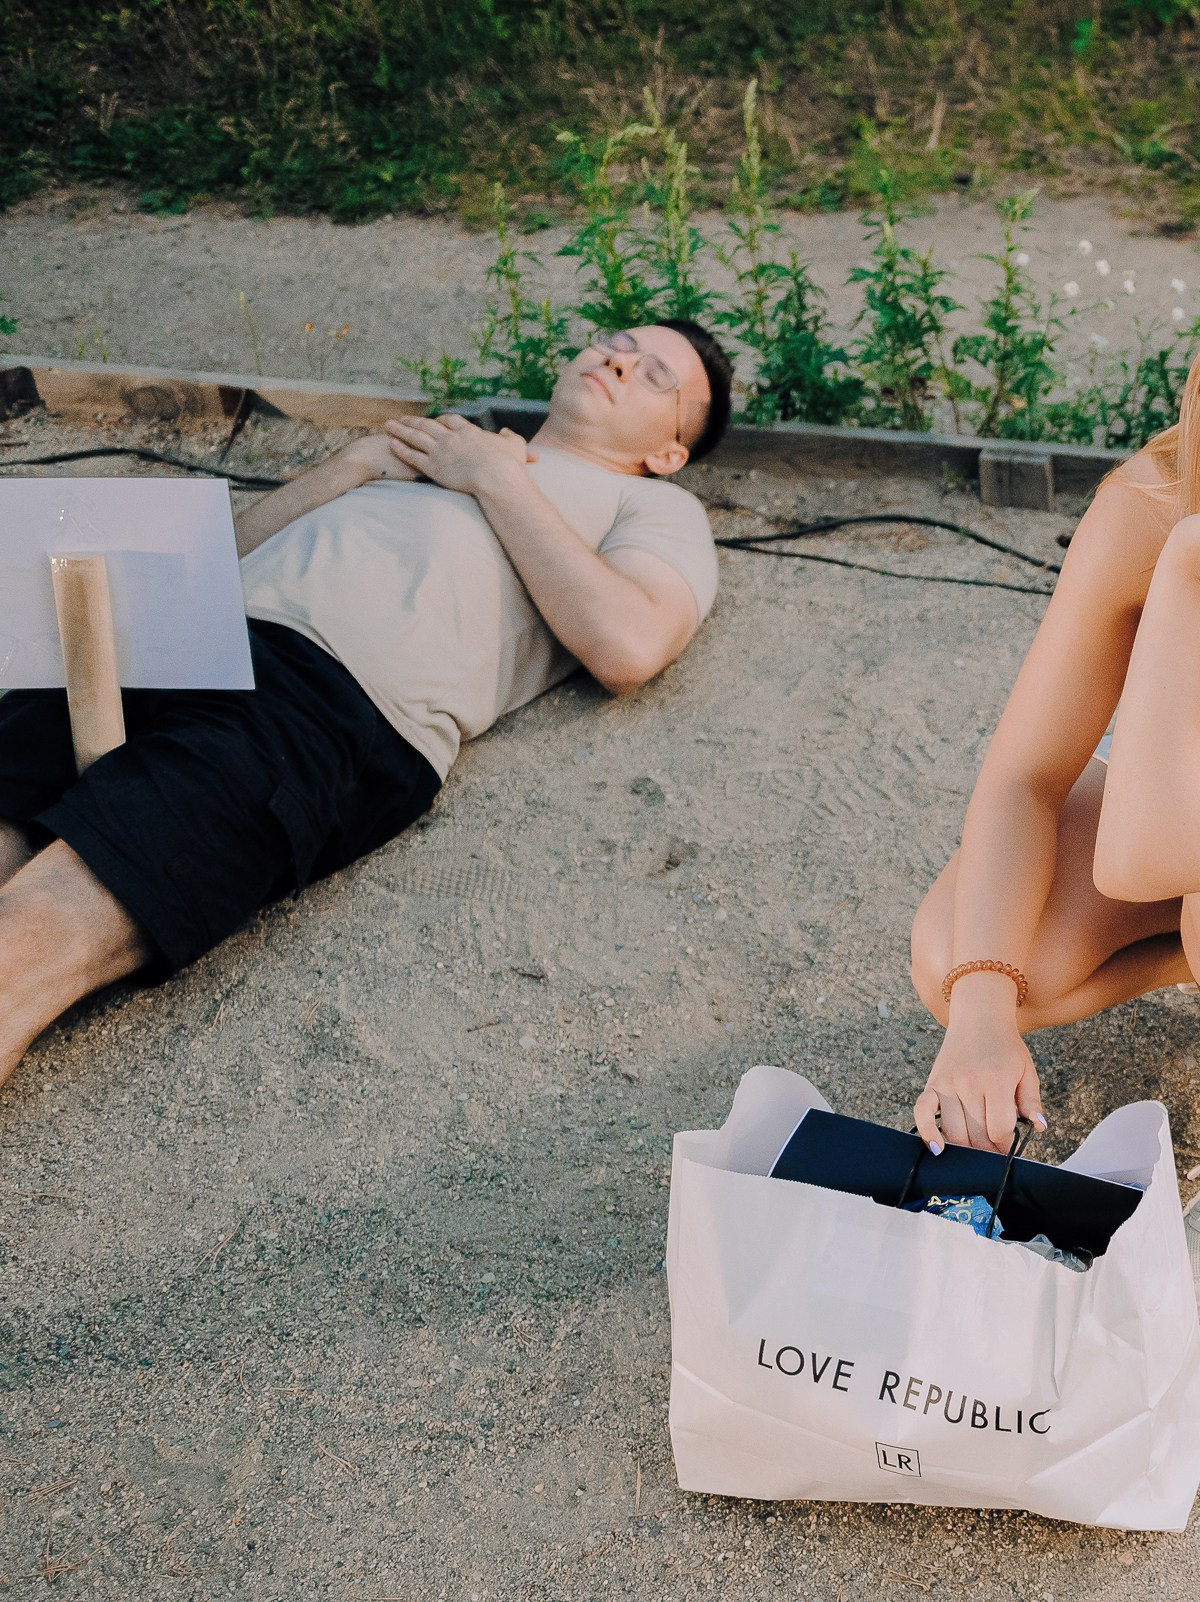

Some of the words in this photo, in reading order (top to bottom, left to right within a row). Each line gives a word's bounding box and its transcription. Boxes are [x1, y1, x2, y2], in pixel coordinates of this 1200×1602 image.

[757, 1338, 854, 1392] LOVE
[878, 1369, 1052, 1434] REPUBLIC
[881, 1449, 914, 1471] LR
